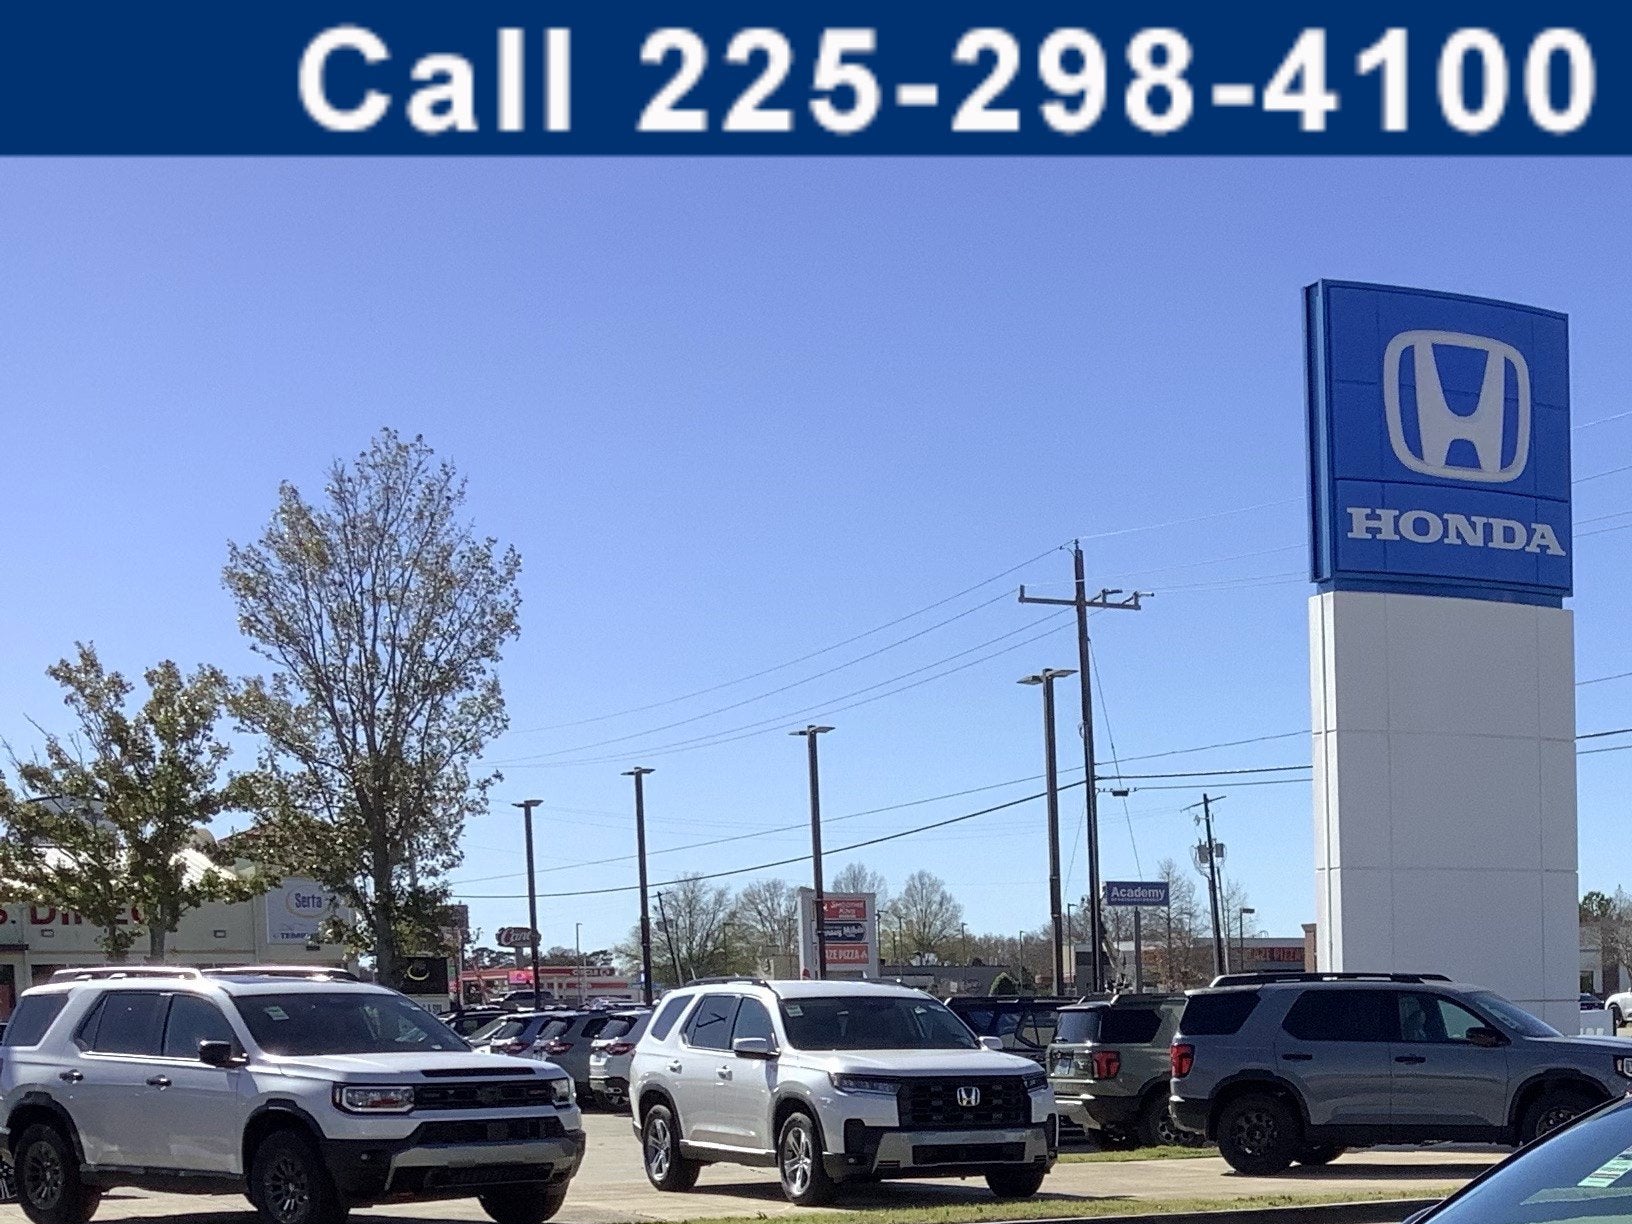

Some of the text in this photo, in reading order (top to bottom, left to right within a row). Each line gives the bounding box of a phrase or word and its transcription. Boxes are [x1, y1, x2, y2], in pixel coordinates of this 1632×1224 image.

[1347, 507, 1566, 557] HONDA
[294, 892, 323, 909] Serta
[1111, 886, 1165, 900] Academy
